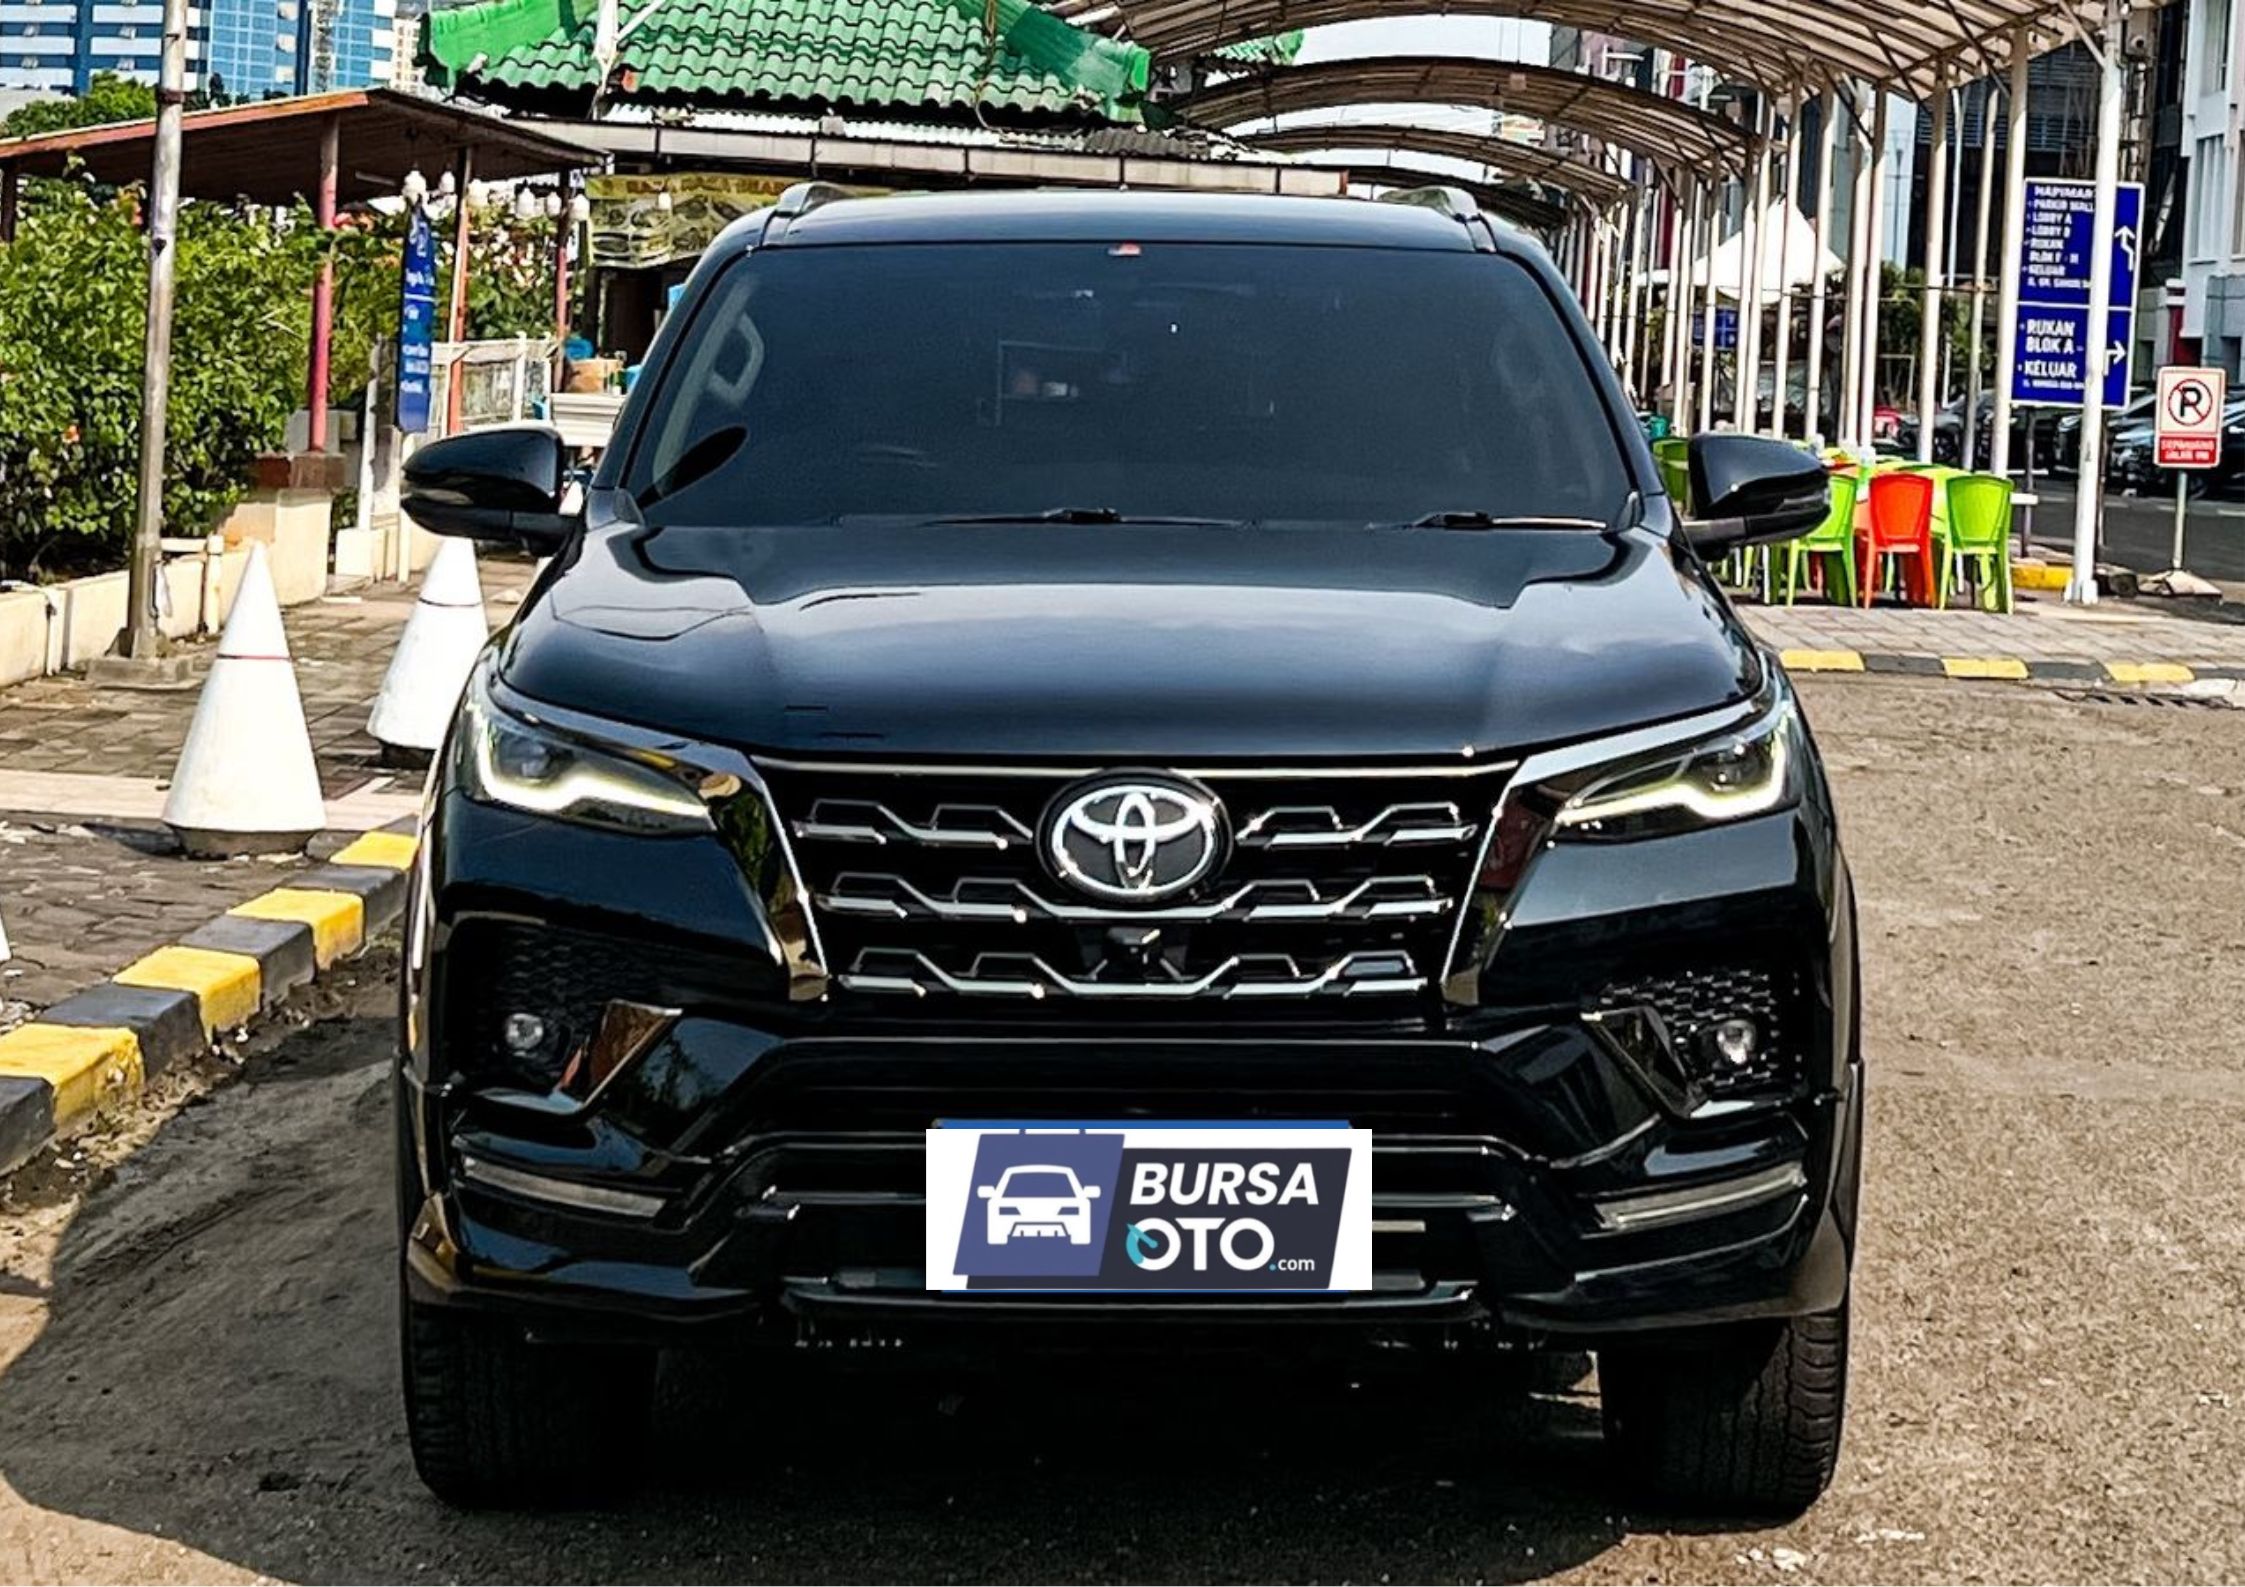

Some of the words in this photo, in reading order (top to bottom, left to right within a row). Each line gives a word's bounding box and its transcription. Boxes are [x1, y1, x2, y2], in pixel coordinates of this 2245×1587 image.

[2032, 212, 2063, 224] LOBBY
[2064, 213, 2072, 225] A
[2031, 225, 2062, 237] LOBBY
[2030, 238, 2064, 250] RUKAN
[2029, 251, 2054, 263] BLOK
[2028, 264, 2066, 276] KELUAR
[2026, 318, 2075, 337] RUKAN
[2025, 336, 2060, 353] BLOK
[2062, 338, 2075, 355] A
[2024, 359, 2077, 378] KELUAR
